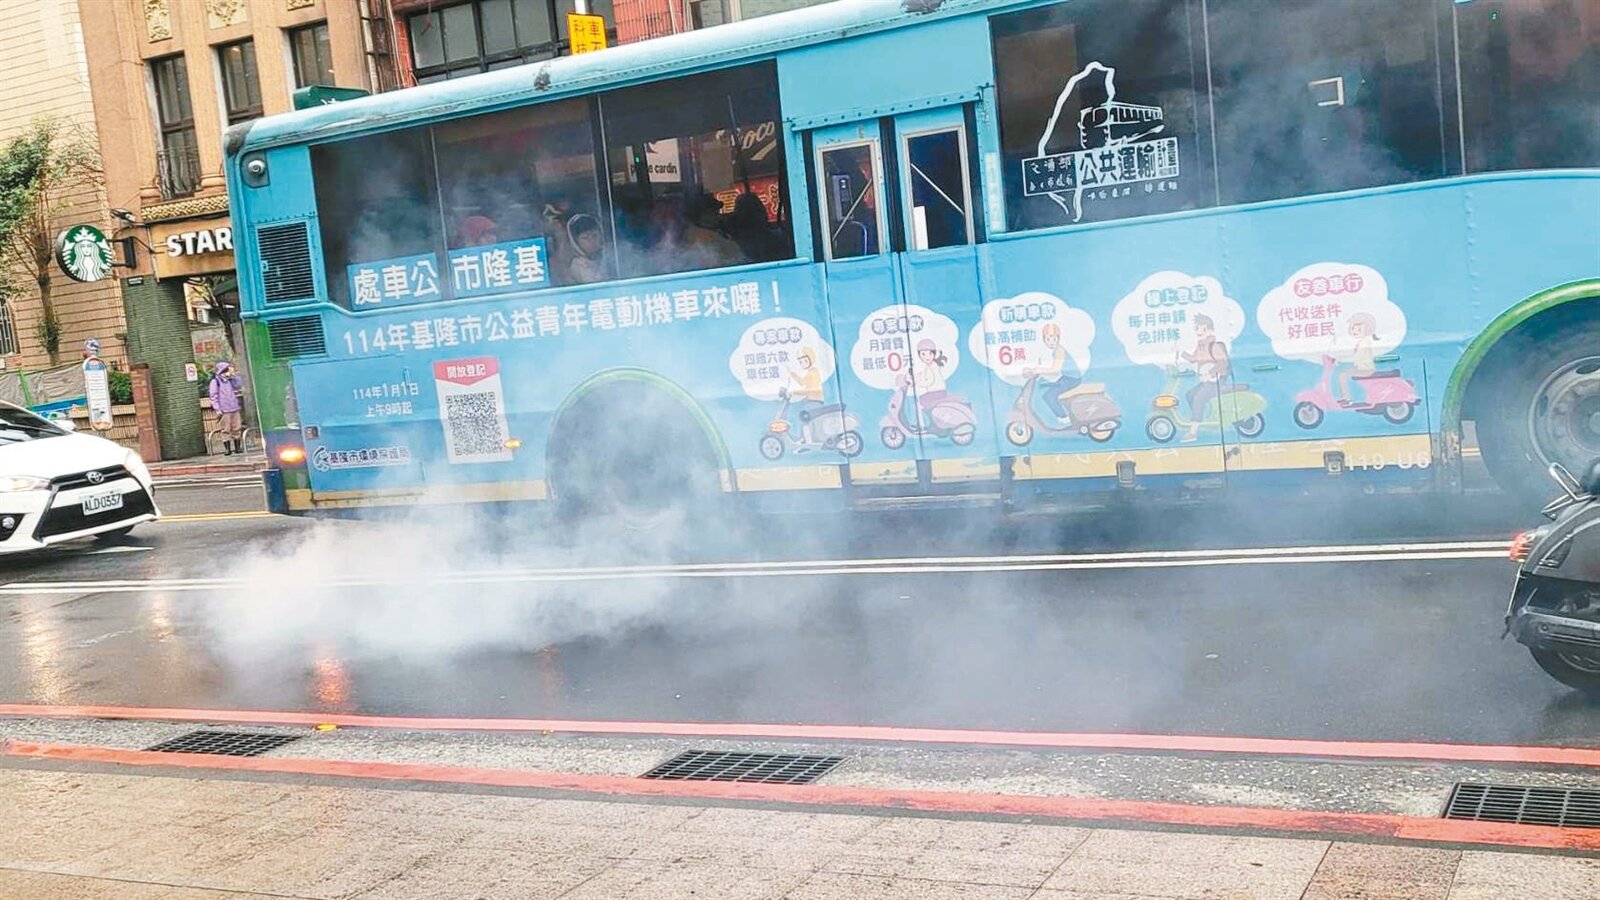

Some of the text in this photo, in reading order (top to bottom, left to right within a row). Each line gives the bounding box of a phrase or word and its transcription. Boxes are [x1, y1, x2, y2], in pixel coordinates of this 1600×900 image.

[1128, 309, 1186, 328] 每月申請
[1279, 303, 1342, 322] 代收送件
[985, 328, 1036, 345] 最高補助
[1137, 328, 1181, 345] 免排隊
[1286, 321, 1335, 340] 好便民
[999, 345, 1026, 366] 6萬
[446, 363, 487, 379] 開放登記
[365, 401, 413, 418] 上午9時起
[84, 493, 121, 512] ALD-0337
